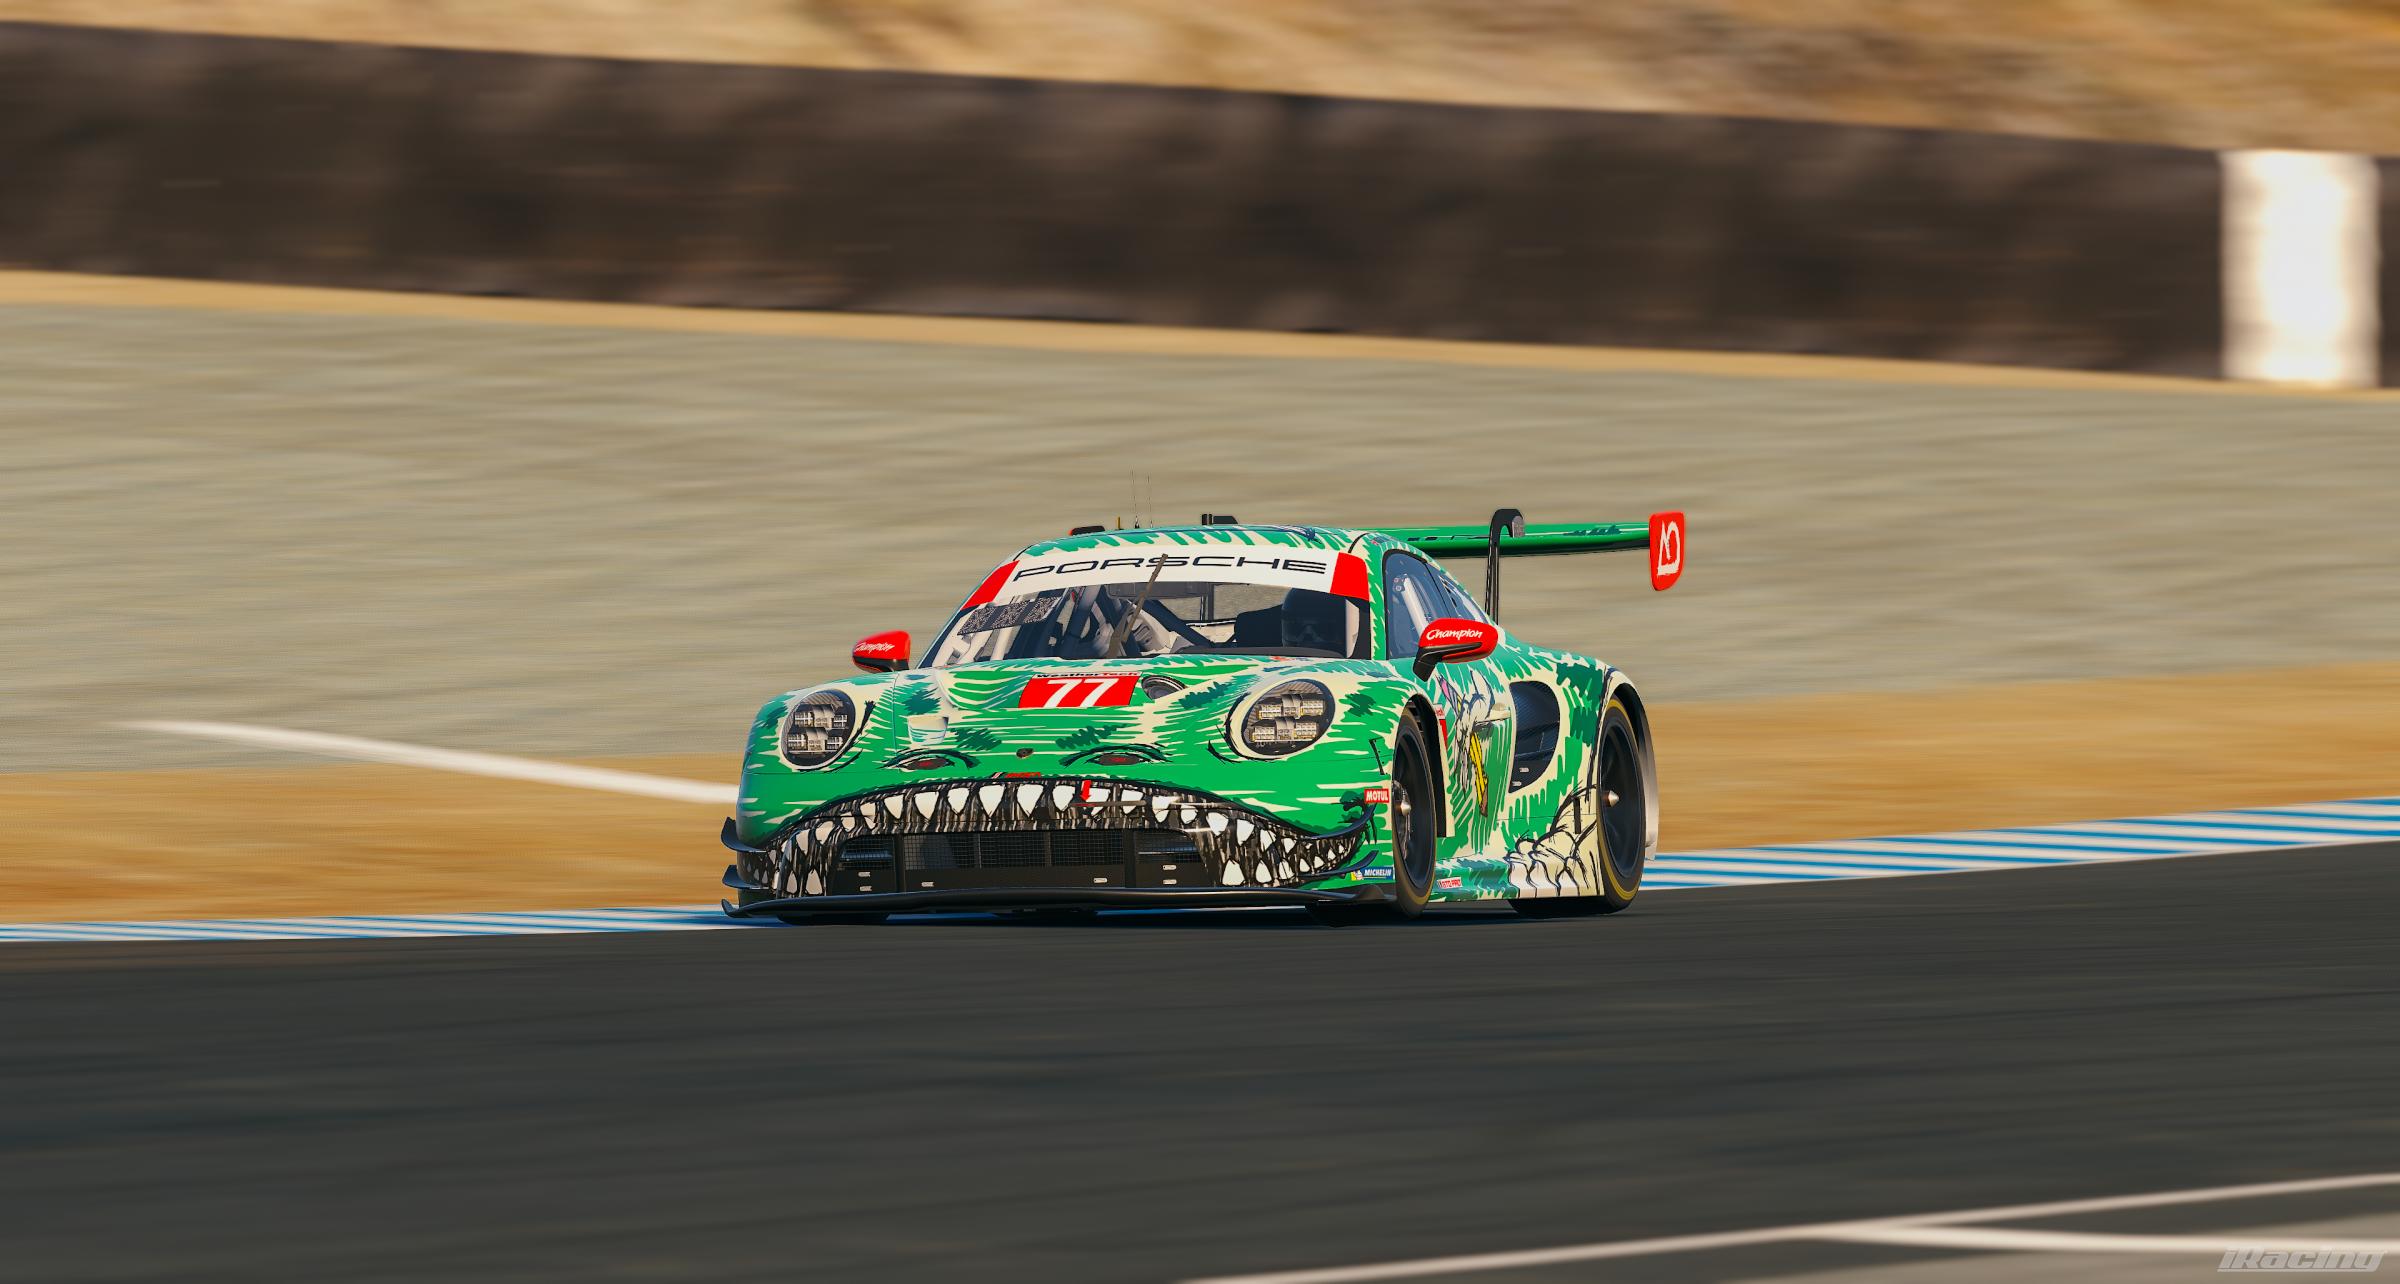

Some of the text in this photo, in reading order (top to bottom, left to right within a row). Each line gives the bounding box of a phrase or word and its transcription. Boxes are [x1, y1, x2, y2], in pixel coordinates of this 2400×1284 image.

[1013, 556, 1327, 582] PORSCHE
[1426, 628, 1483, 641] Champion
[1043, 678, 1120, 709] 77
[1366, 790, 1389, 802] MOTUL
[1363, 868, 1392, 877] MICHELIN
